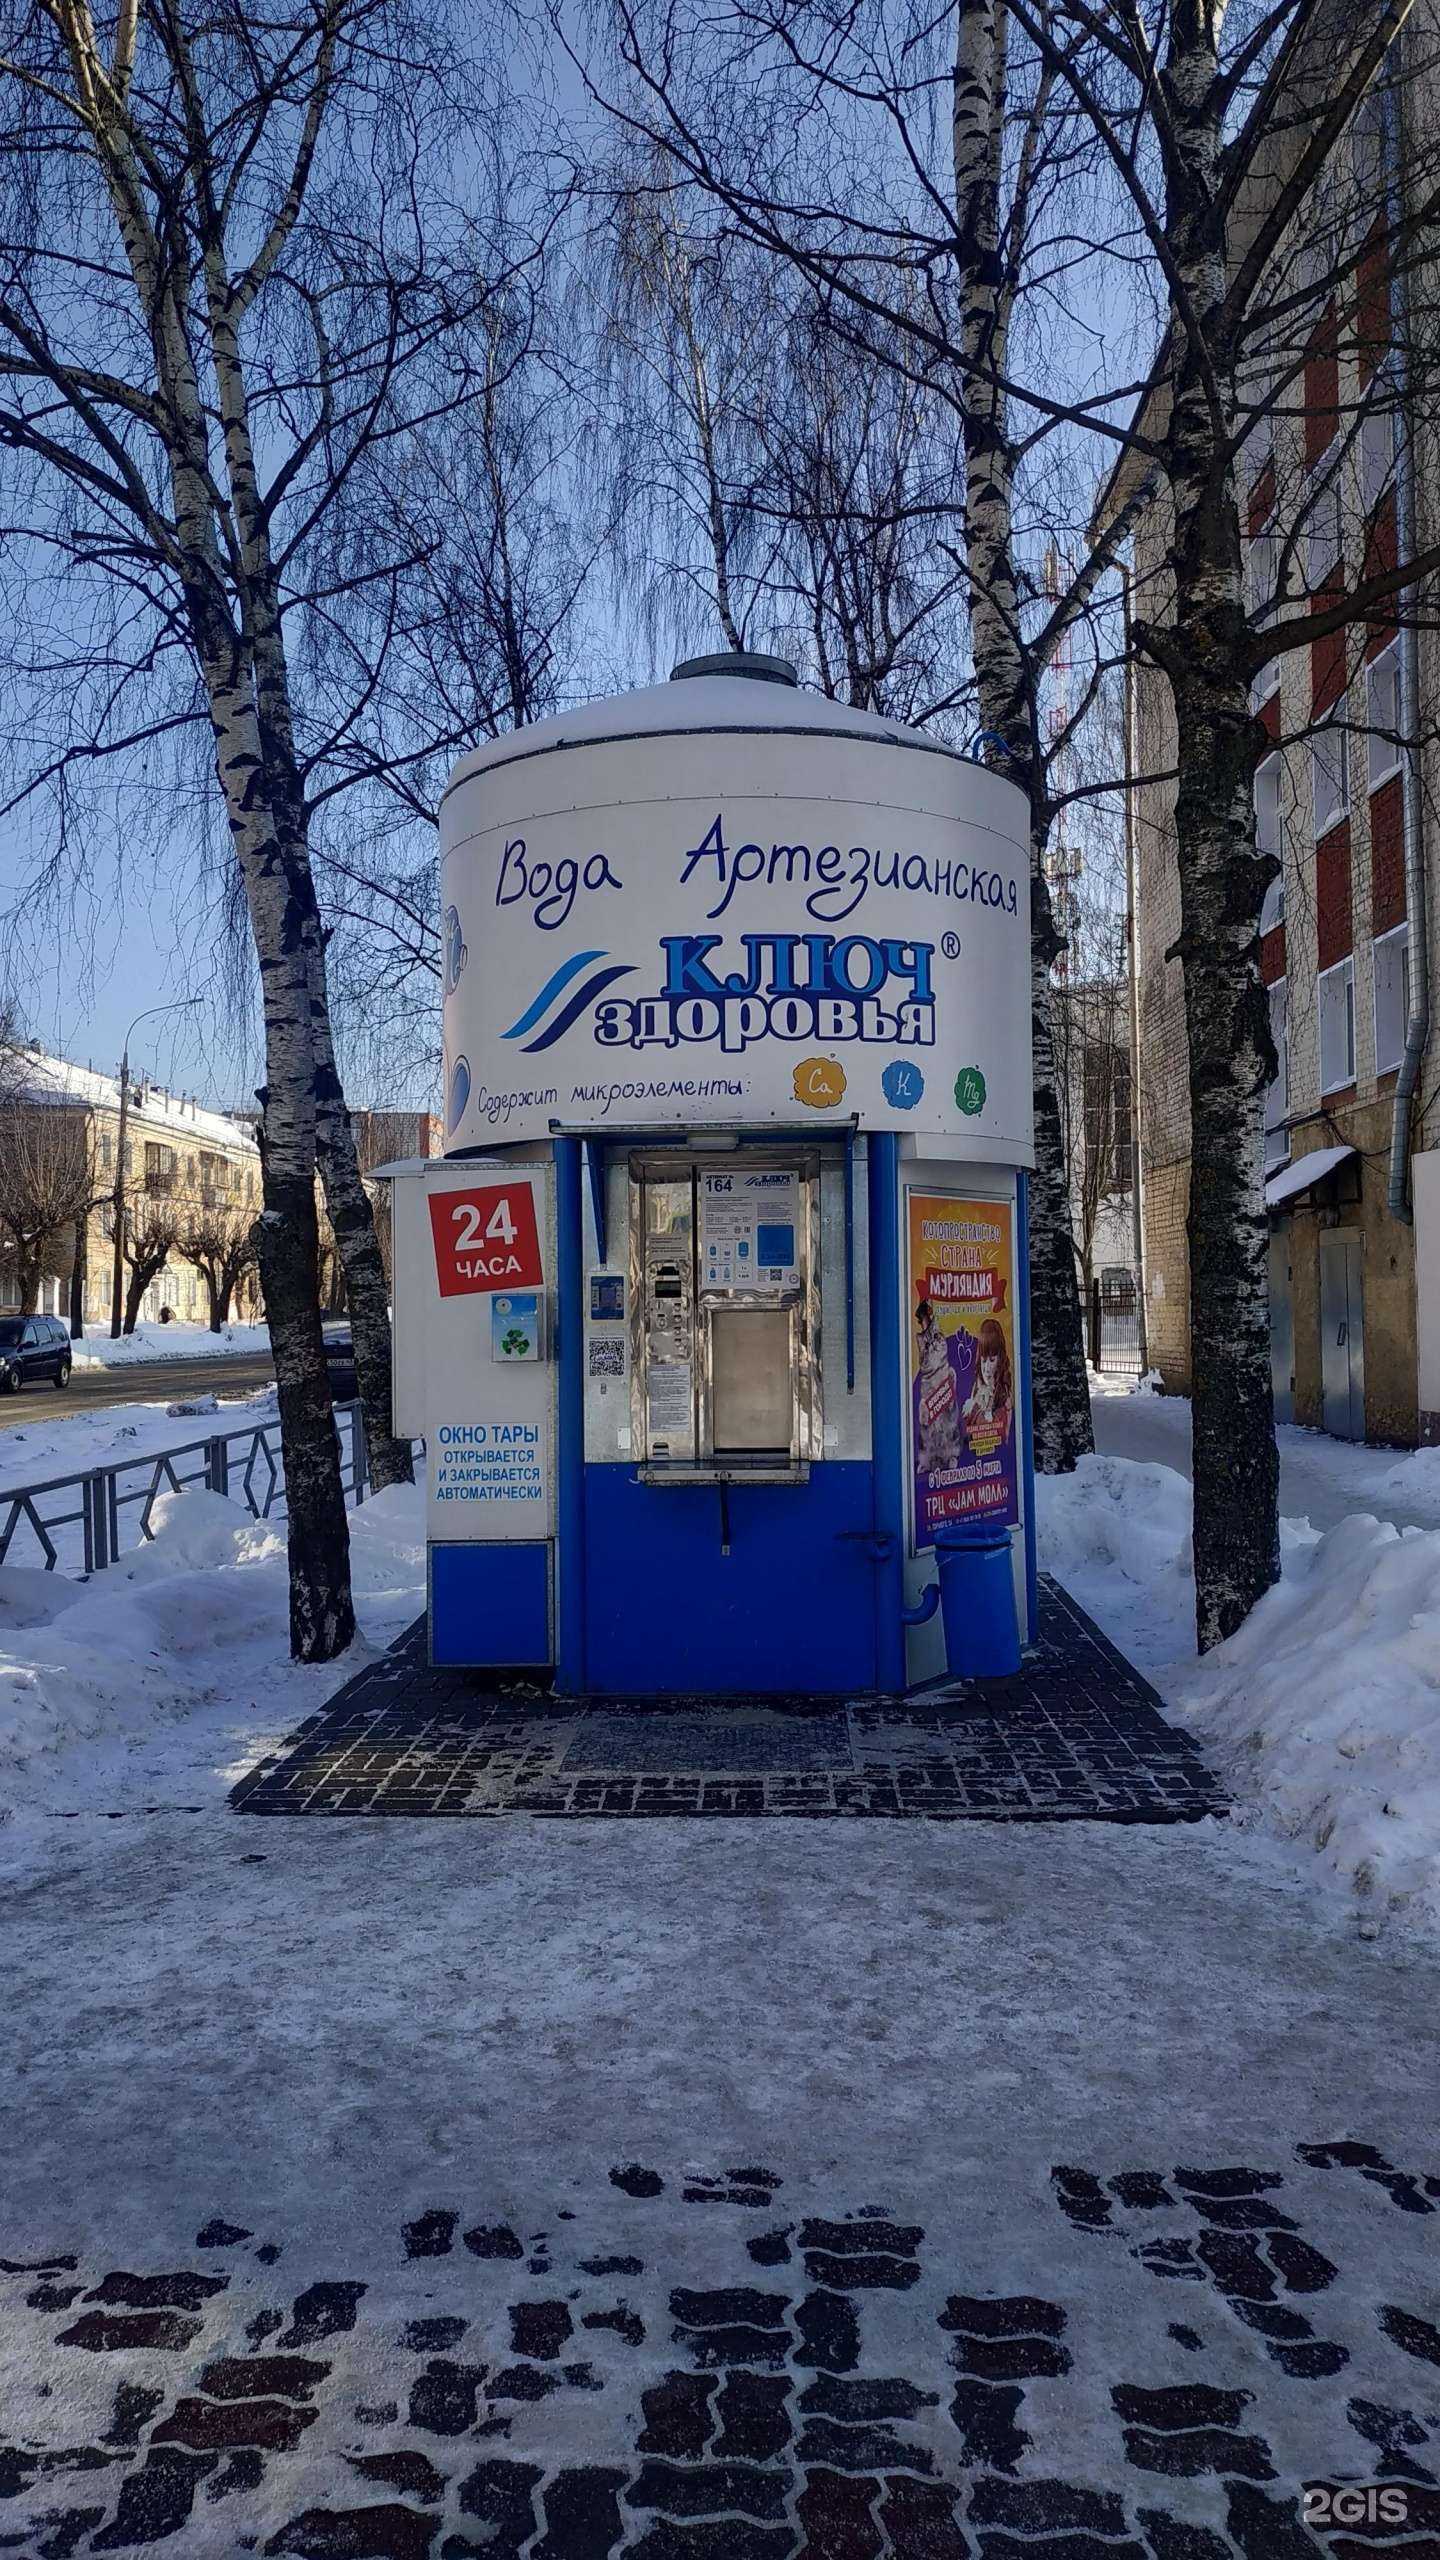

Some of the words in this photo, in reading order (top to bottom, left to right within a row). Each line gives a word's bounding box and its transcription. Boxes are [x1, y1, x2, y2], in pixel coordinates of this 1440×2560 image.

[496, 839, 623, 930] Вода
[680, 814, 1018, 922] Артезианская
[659, 932, 935, 1000] КЛЮЧ
[594, 994, 935, 1053] здоровья
[478, 1086, 558, 1124] Содержит
[571, 1077, 752, 1115] микроэлементы:
[705, 1179, 733, 1192] 164
[451, 1199, 518, 1251] 24
[922, 1220, 1001, 1243] КОТОПРОСТРАНСТВО
[456, 1255, 522, 1279] ЧАСА
[941, 1245, 982, 1267] СТРАНА
[930, 1272, 993, 1297] МУРЛЯНДИЯ
[439, 1426, 487, 1444] ОКНО
[492, 1425, 538, 1443] ТАРЫ
[444, 1450, 534, 1463] ОТКРЫВАЕТСЯ
[439, 1469, 447, 1481] И
[450, 1468, 540, 1481] ЗАКРЫВАЕТСЯ
[437, 1486, 542, 1500] АВТОМАТИЧЕСКИ
[926, 1495, 945, 1517] ТРЦ
